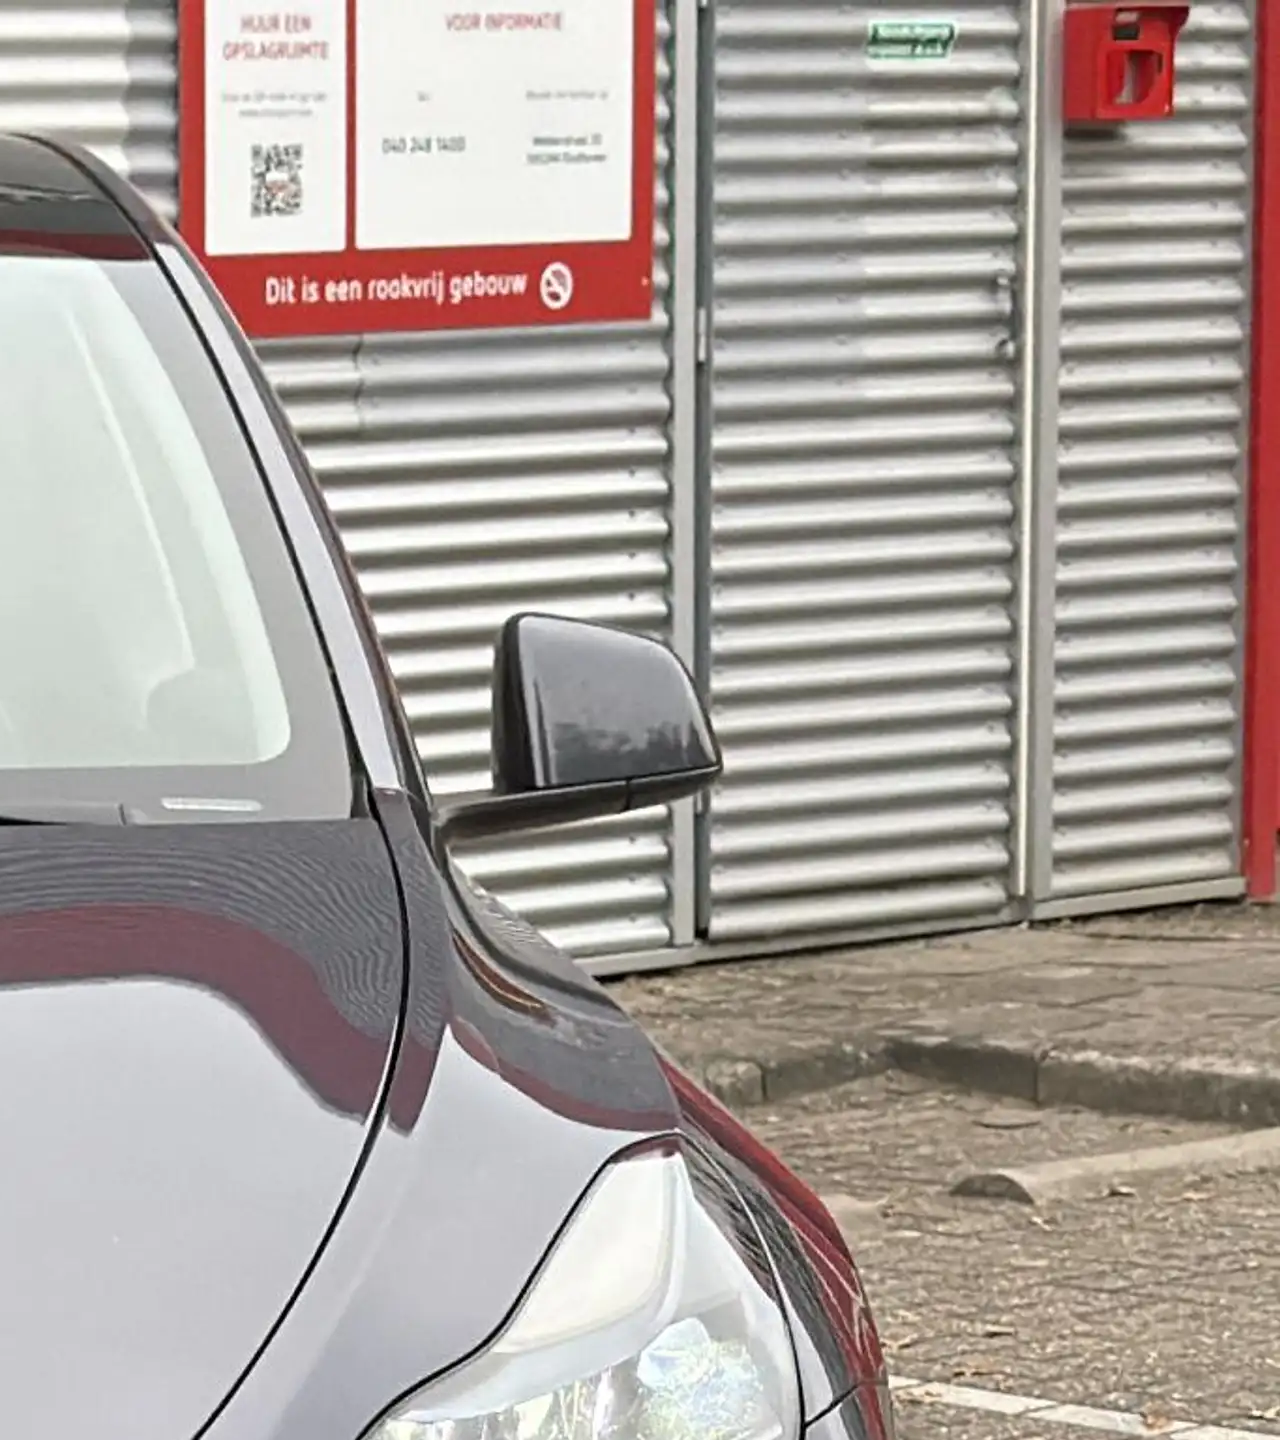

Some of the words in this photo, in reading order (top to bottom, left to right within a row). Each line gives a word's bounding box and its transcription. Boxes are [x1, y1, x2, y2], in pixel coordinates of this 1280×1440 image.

[444, 12, 480, 31] VOOR
[265, 276, 297, 306] Dit
[302, 274, 319, 303] is
[325, 279, 362, 303] een
[368, 269, 444, 306] rookvrij
[449, 270, 528, 304] gebouw
